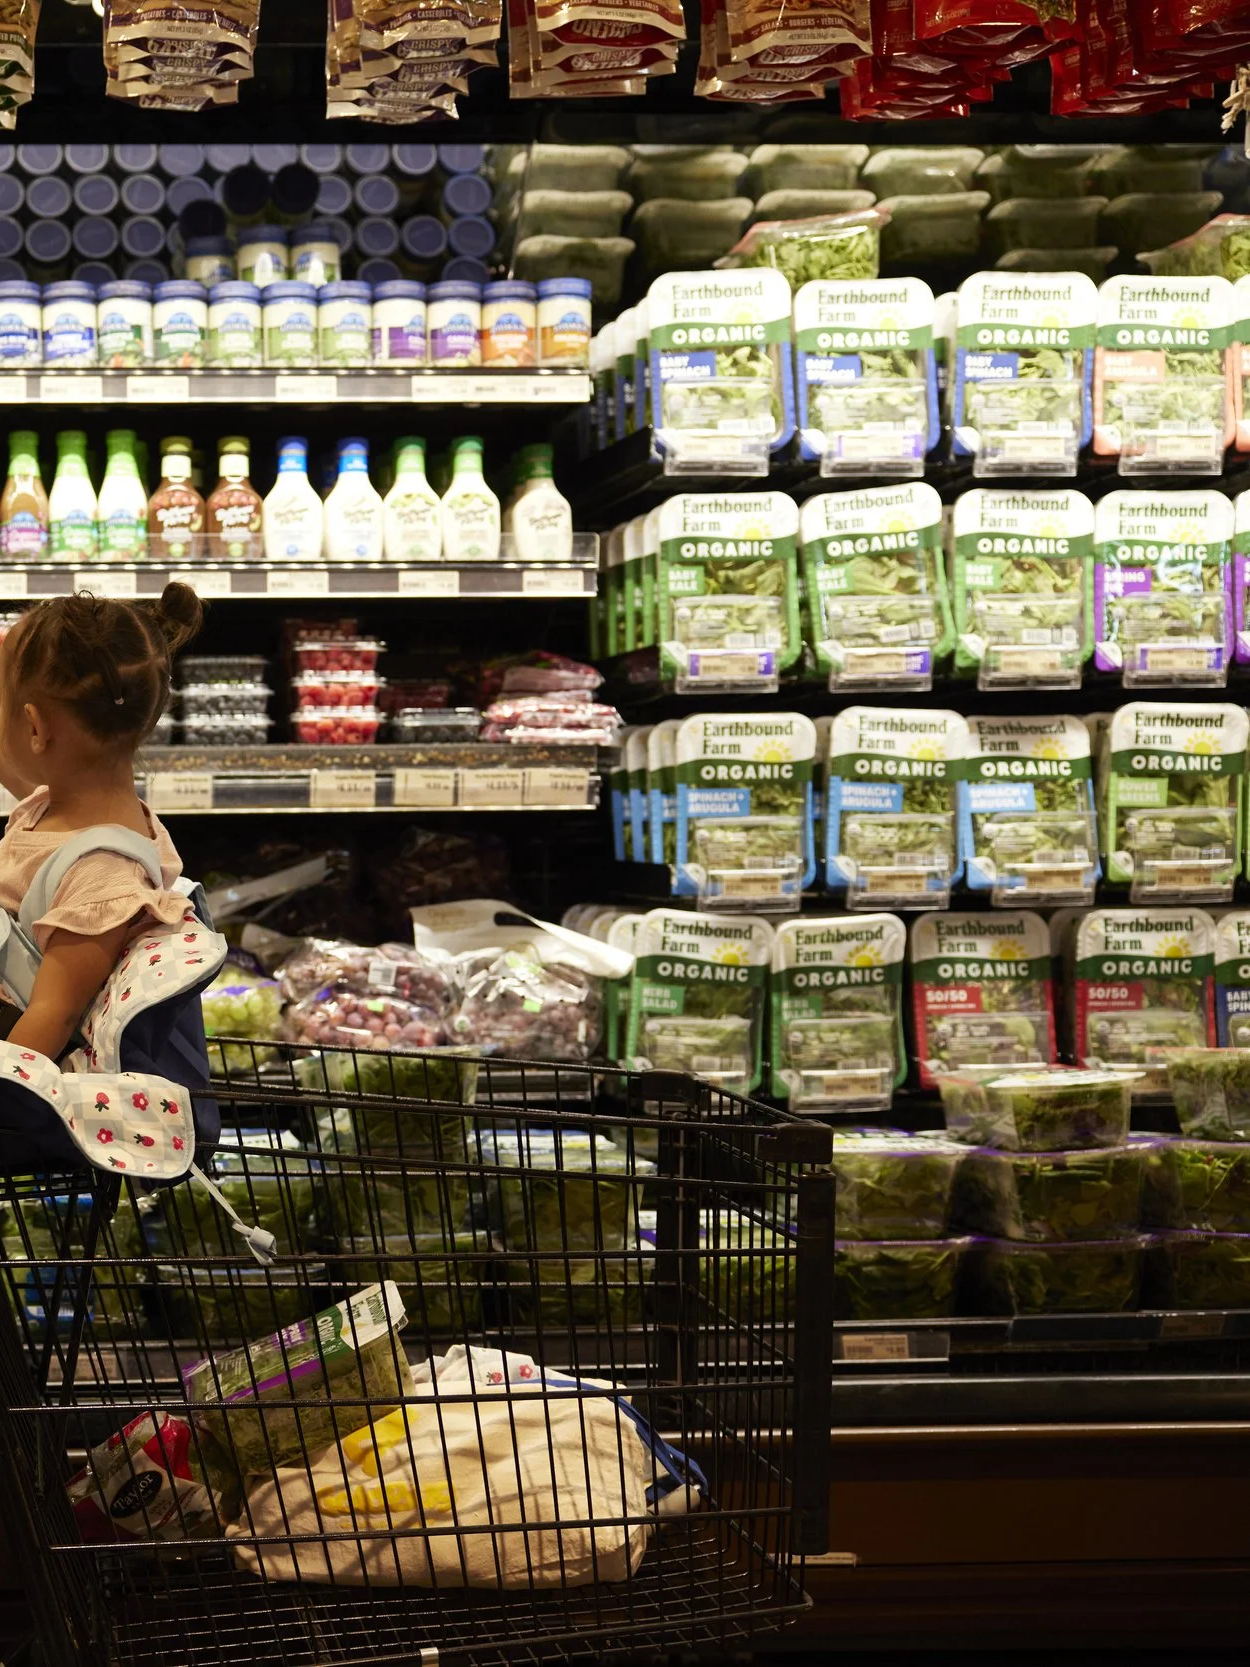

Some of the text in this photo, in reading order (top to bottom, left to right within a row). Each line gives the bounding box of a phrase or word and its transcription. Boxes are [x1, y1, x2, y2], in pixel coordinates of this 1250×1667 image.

[417, 9, 452, 18] CASSEROLES
[410, 40, 453, 49] CRISPY
[413, 62, 454, 73] CRISPY
[672, 281, 763, 301] Earthbound
[818, 288, 908, 305] Earthbound
[982, 284, 1072, 301] Earthbound
[1120, 286, 1210, 302] Earthbound
[673, 302, 711, 319] Farm
[818, 306, 856, 323] Farm
[981, 302, 1018, 318] Farm
[1119, 303, 1158, 320] Farm
[671, 324, 766, 345] ORGANIC
[817, 331, 910, 349] ORGANIC
[977, 328, 1070, 346] ORGANIC
[1116, 329, 1210, 346] ORGANIC
[682, 498, 773, 514] Earthbound
[824, 492, 914, 514] Earthbound
[981, 495, 1070, 511] Earthbound
[1119, 502, 1209, 518] Earthbound
[682, 516, 721, 533] Farm
[825, 515, 864, 532] Farm
[980, 511, 1018, 528] Farm
[1118, 519, 1157, 536] Farm
[680, 541, 773, 559] ORGANIC
[826, 531, 919, 557] ORGANIC
[977, 537, 1070, 555] ORGANIC
[1116, 544, 1208, 561] ORGANIC
[703, 721, 794, 737] Earthbound
[858, 715, 948, 734] Earthbound
[977, 719, 1067, 736] Earthbound
[1134, 712, 1225, 729] Earthbound
[858, 733, 896, 750] Farm
[980, 736, 1020, 753] Farm
[1134, 729, 1172, 746] Farm
[703, 738, 742, 755] Farm
[854, 758, 947, 778] ORGANIC
[980, 760, 1072, 777] ORGANIC
[1131, 754, 1223, 772] ORGANIC
[700, 763, 794, 781] ORGANIC
[663, 917, 754, 940] Earthbound
[935, 919, 1026, 938] Earthbound
[1103, 915, 1195, 934] Earthbound
[661, 935, 700, 954] Farm
[795, 925, 884, 947] Earthbound
[1104, 934, 1144, 951] Farm
[937, 937, 978, 954] Farm
[795, 949, 834, 964] Farm
[657, 961, 750, 983] ORGANIC
[937, 961, 1029, 979] ORGANIC
[1102, 959, 1193, 976] ORGANIC
[794, 967, 886, 988] ORGANIC
[925, 989, 968, 1003] 50/50
[1087, 986, 1129, 1000] 50/50
